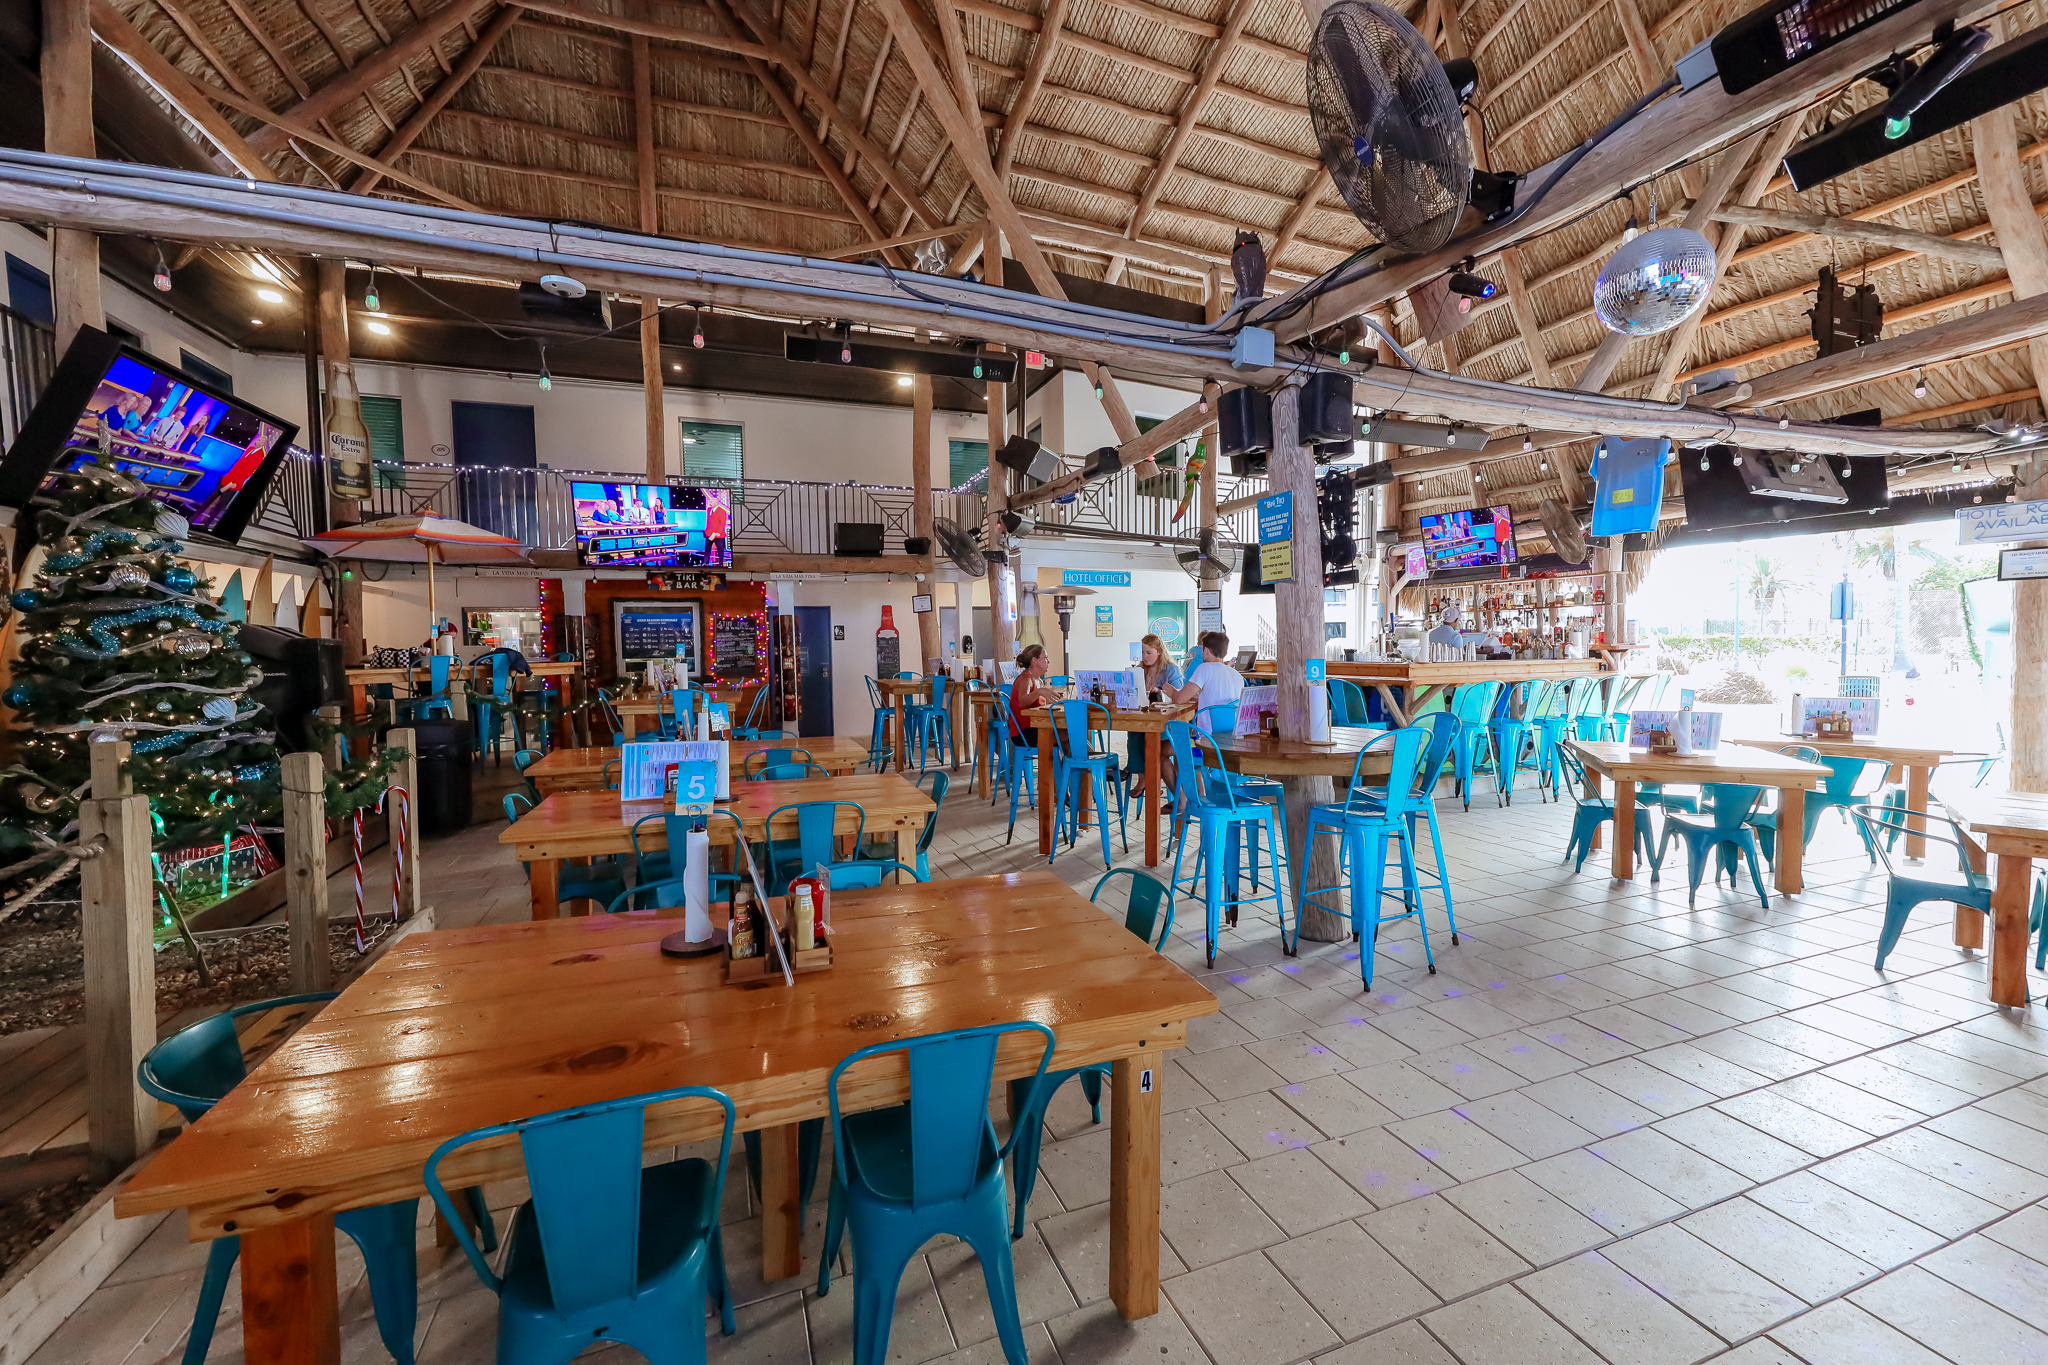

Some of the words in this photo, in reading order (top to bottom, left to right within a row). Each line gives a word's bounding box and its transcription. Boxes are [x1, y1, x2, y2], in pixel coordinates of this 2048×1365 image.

[332, 434, 366, 448] Corona
[341, 444, 360, 454] Extra
[1064, 574, 1093, 582] HOTEL
[1095, 574, 1122, 583] OFFICE
[1311, 666, 1319, 678] 9
[688, 776, 705, 799] 5
[1142, 1071, 1151, 1091] 4
